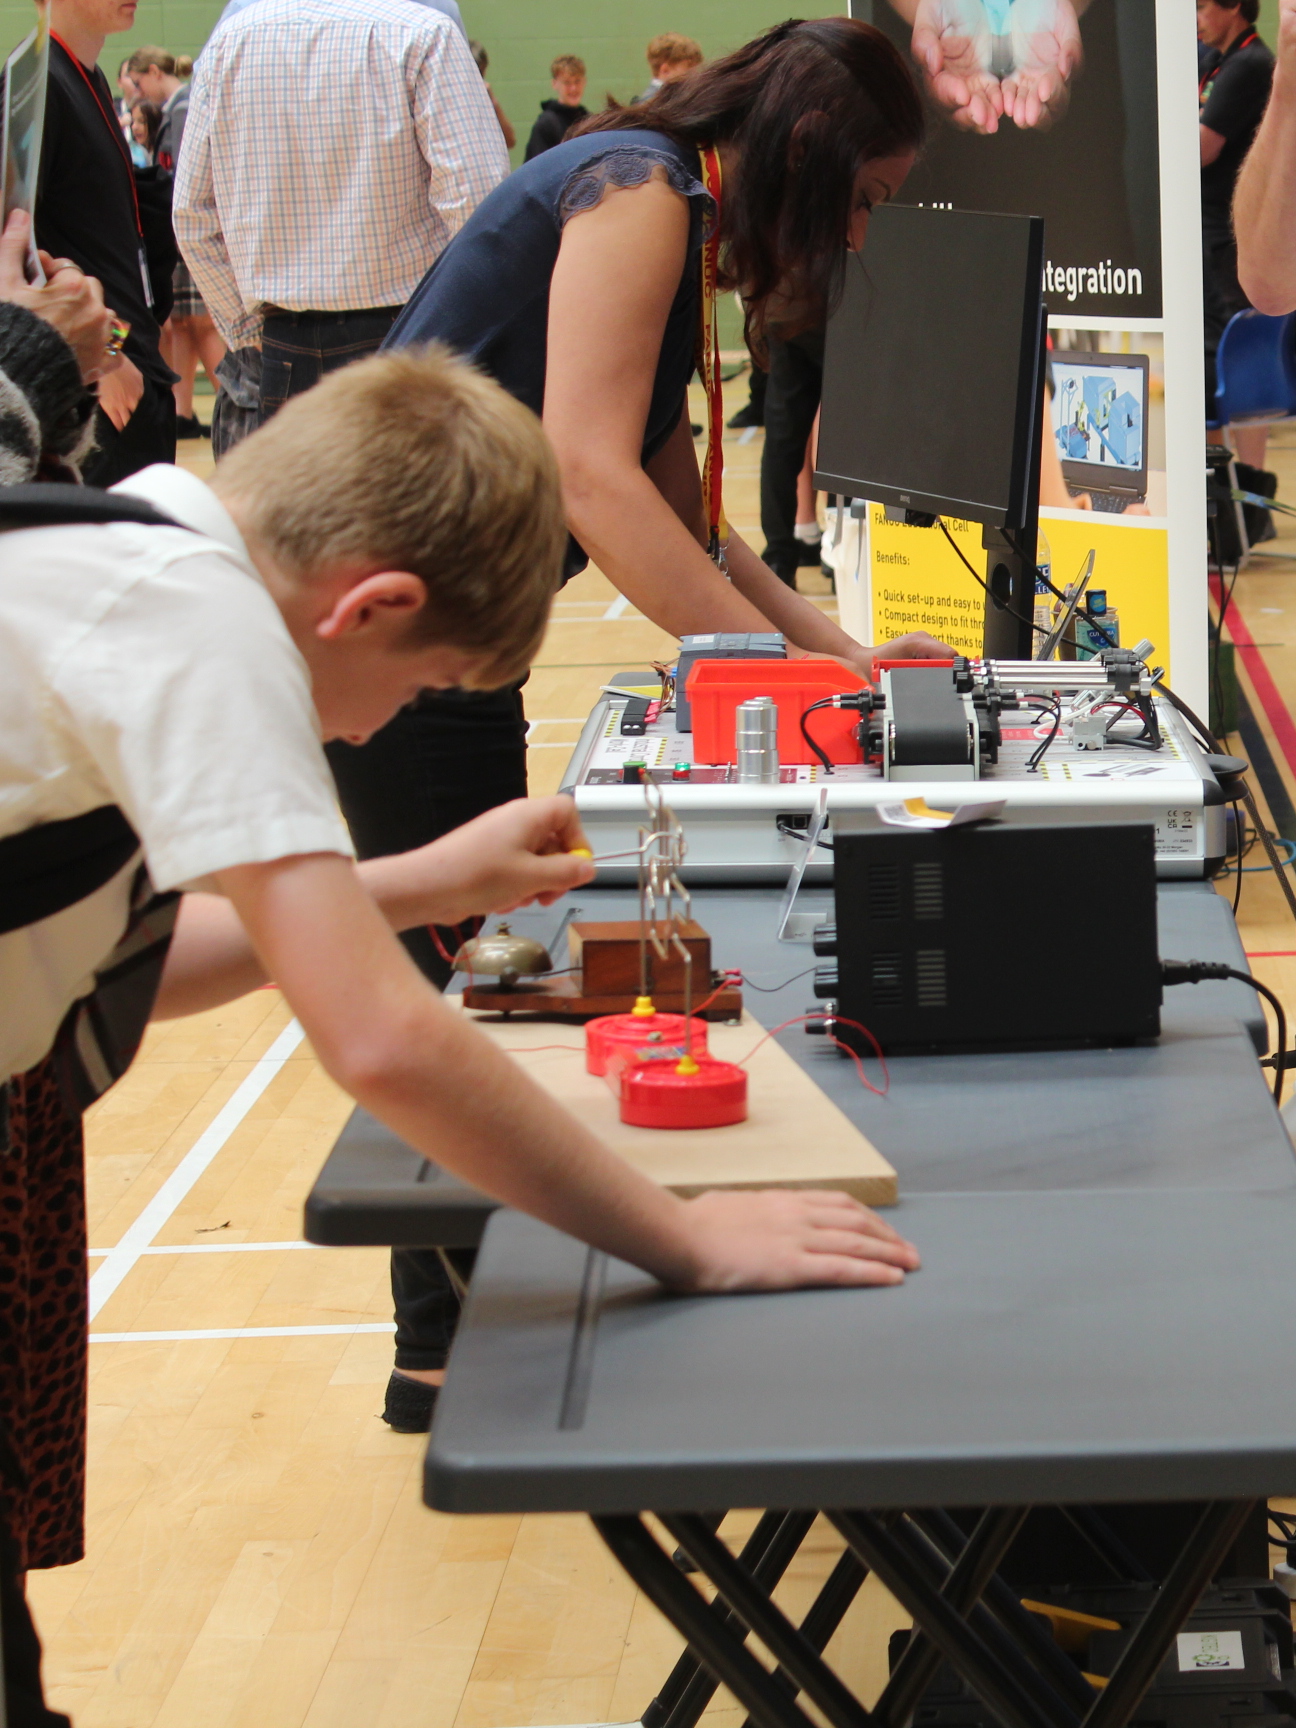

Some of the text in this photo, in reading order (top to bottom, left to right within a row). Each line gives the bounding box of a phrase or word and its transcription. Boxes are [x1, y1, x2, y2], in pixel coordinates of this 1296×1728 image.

[1042, 259, 1143, 301] tegration
[953, 519, 969, 533] Cell
[876, 551, 910, 566] Benefits:
[883, 589, 981, 611] Quick set-up and easy to
[884, 608, 919, 624] Compact
[921, 612, 948, 628] design
[950, 616, 958, 627] to
[960, 616, 968, 628] fit
[946, 633, 973, 648] thanks
[975, 638, 983, 649] to
